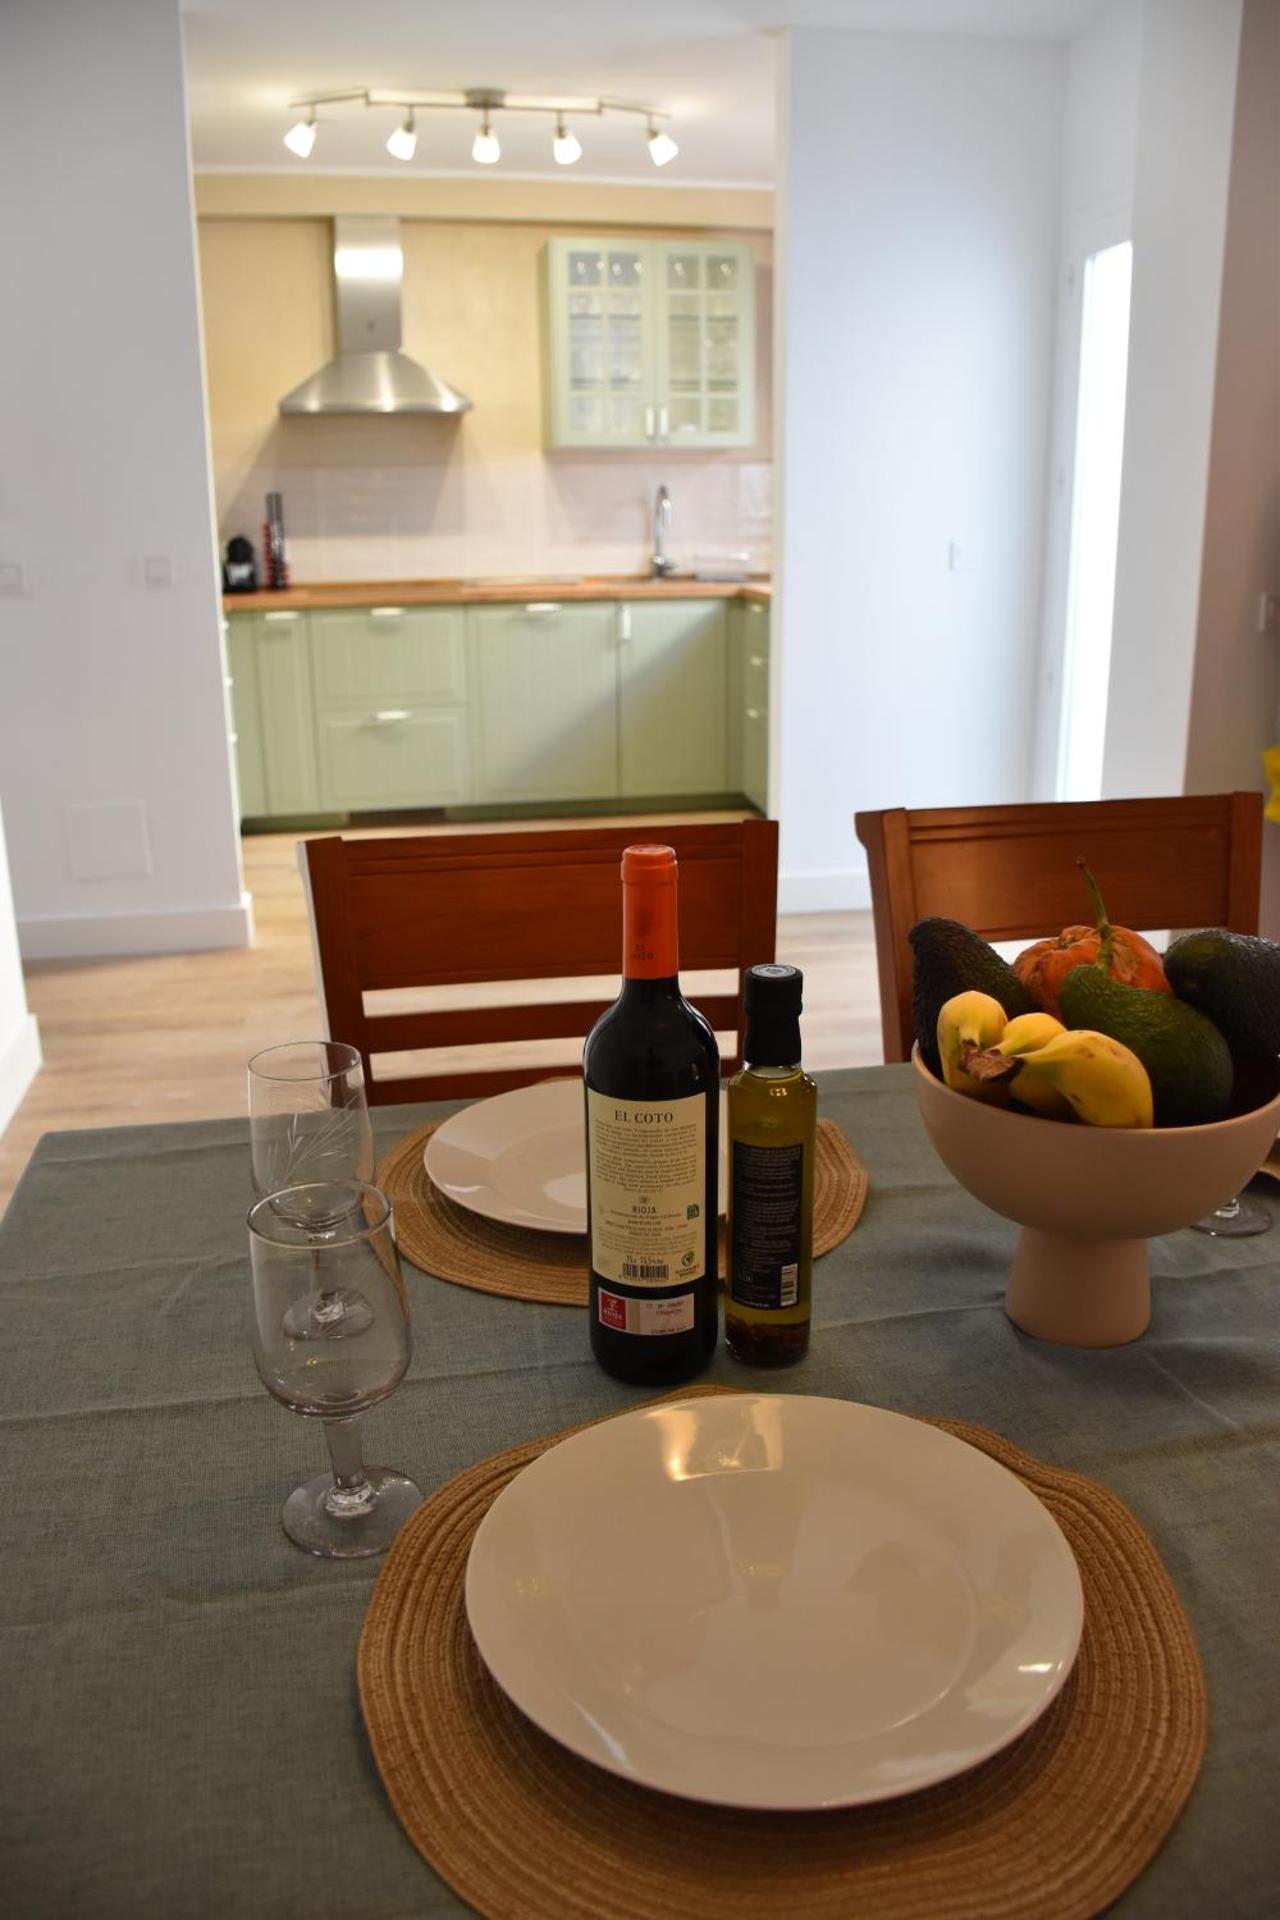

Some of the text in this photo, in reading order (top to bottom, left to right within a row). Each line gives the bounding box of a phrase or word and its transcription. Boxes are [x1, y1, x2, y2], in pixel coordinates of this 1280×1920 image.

[614, 1110, 674, 1124] EL COTO
[631, 1205, 657, 1214] RIOJA
